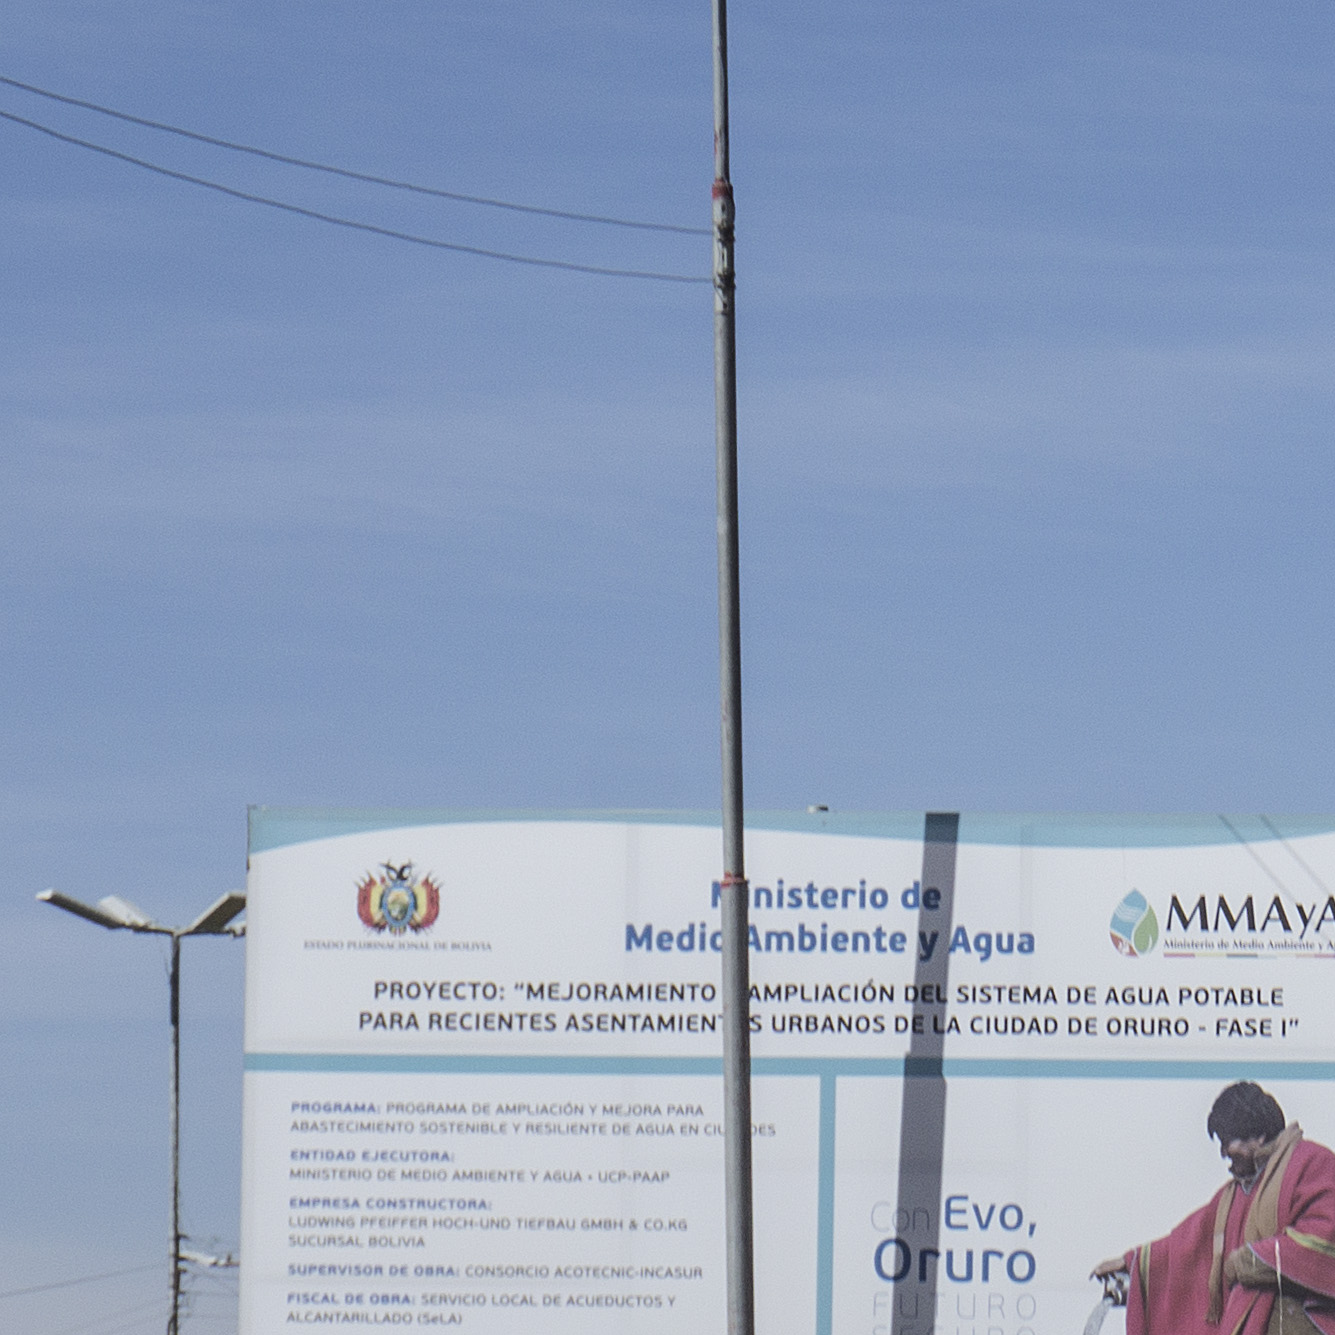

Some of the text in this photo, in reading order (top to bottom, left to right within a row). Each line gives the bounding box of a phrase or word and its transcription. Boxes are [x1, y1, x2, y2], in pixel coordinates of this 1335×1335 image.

[711, 879, 942, 910] nisterio de
[304, 939, 492, 952] ESTADO PLURINACIONAL DE BOLIVIA
[918, 931, 939, 962] y
[948, 926, 1036, 962] Agua
[1163, 938, 1215, 950] Ministerio
[1217, 939, 1230, 950] de
[1233, 939, 1265, 950] Medio
[1268, 939, 1315, 951] Ambiente
[374, 981, 505, 1000] PROYECTO:
[749, 979, 894, 1003] AMPLIACIÓN
[904, 984, 948, 1004] DEL
[956, 985, 1058, 1005] SISTEMA
[1066, 985, 1097, 1005] DE
[1105, 986, 1170, 1006] AGUA
[1178, 987, 1284, 1007] POTABLE
[358, 1011, 420, 1031] PARA
[428, 1012, 557, 1032] RECIENTES
[565, 1013, 762, 1034] ASENTAMIENS
[771, 1014, 885, 1035] URBANOS
[894, 1015, 924, 1035] DE
[932, 1015, 961, 1035] LA
[970, 1016, 1058, 1035] CIUDAD
[1067, 1017, 1098, 1036] DE
[1106, 1017, 1190, 1037] ORURO
[1215, 1018, 1273, 1037] FASE
[291, 1101, 704, 1117] PROGRAMA: PROGRAMA DE AMPLIACIÓN Y MEJORA PARA
[290, 1120, 415, 1134] ABASTECIMIENTO
[420, 1121, 507, 1135] SOSTENIBLE
[512, 1122, 521, 1135] Y
[526, 1122, 607, 1136] RESILIENTE
[612, 1123, 631, 1136] DE
[635, 1123, 675, 1136] AGUA
[680, 1123, 699, 1137] EN
[290, 1149, 455, 1163] ENTIDAD EJECUTORA:
[289, 1168, 372, 1181] MINISTERIO
[377, 1169, 396, 1182] DE
[401, 1169, 447, 1182] MEDIO
[452, 1169, 525, 1183] AMBIENTE
[530, 1170, 539, 1183] Y
[543, 1170, 582, 1183] AGUA
[598, 1170, 670, 1184] UCP-PAAP
[289, 1197, 492, 1211] EMPRESA CONSTRUCTORA:
[360, 1216, 428, 1230] PFEIFFER
[516, 1217, 576, 1231] TIEFBAU
[581, 1218, 624, 1231] GMBH
[628, 1218, 638, 1231] &
[944, 1194, 1037, 1239] Evo,
[288, 1235, 426, 1249] SUCURSAL BOLIVIA
[873, 1236, 1037, 1284] Oruro
[288, 1264, 383, 1277] SUPERVISOR
[389, 1265, 408, 1278] DE
[414, 1265, 460, 1278] OBRA:
[465, 1265, 549, 1279] CONSORCIO
[287, 1293, 676, 1308] FISCAL DE OBRA: SERVICIO LOCAL DE ACUEDUCTOS Y
[286, 1311, 412, 1325] ALCANTARILLADO
